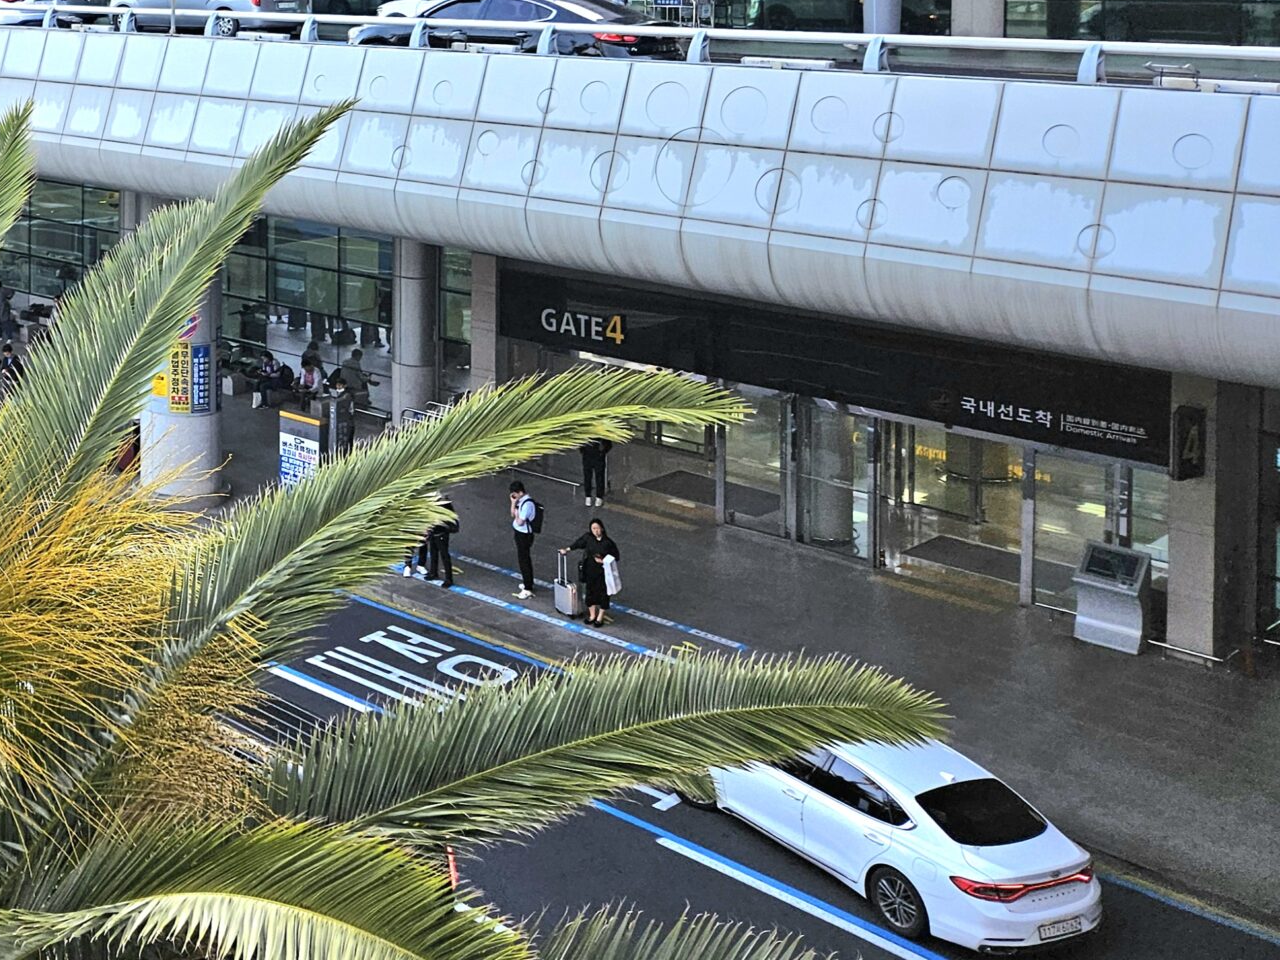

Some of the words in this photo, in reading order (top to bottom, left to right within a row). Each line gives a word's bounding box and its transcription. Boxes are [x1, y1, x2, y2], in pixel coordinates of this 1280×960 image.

[960, 396, 1053, 428] 국내선도착
[1065, 424, 1104, 439] Domestic
[1182, 424, 1201, 464] 4
